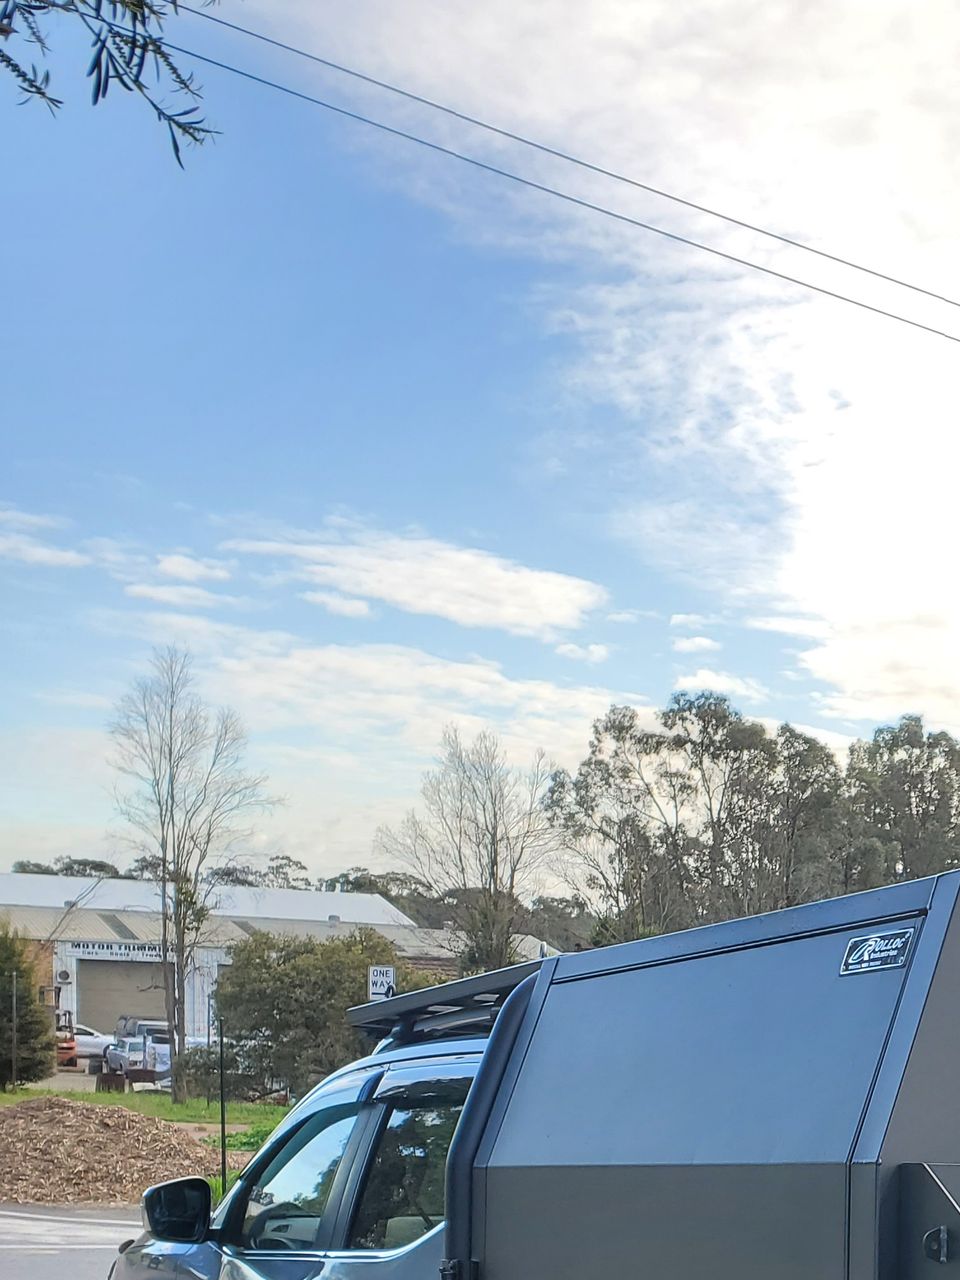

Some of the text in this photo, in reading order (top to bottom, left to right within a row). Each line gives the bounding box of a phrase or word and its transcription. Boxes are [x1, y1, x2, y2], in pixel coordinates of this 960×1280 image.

[71, 942, 113, 951] MOTOR
[373, 969, 391, 978] ONE
[372, 980, 392, 989] WAY
